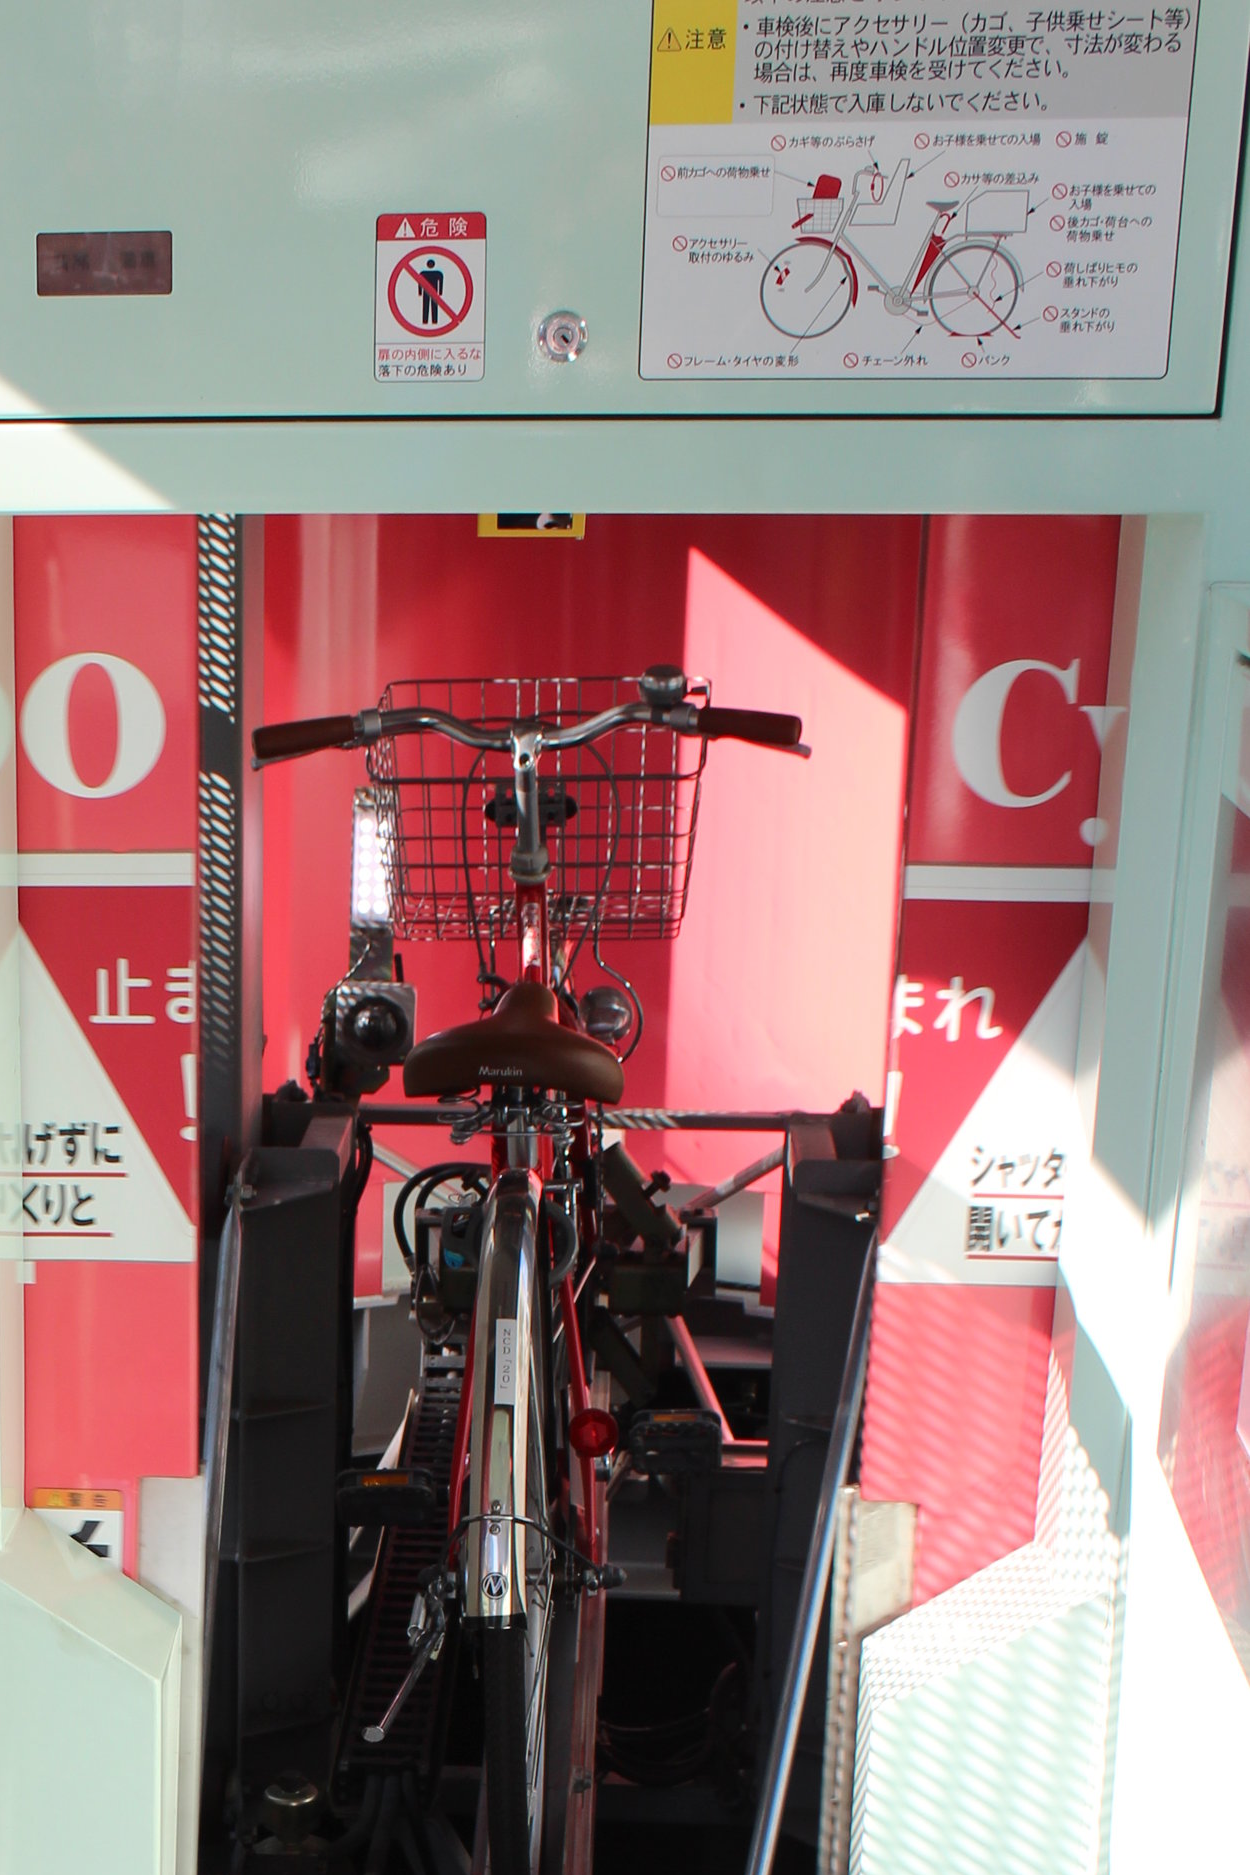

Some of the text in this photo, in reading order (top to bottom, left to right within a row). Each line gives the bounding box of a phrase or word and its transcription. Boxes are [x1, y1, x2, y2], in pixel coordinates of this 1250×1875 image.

[685, 28, 727, 50] 注意
[754, 32, 1182, 60] の付け替えやハンドル位置変更で、寸法が変わる
[754, 59, 1070, 84] 場合は、再度車検を受けてください。
[754, 91, 1049, 115] 下記状態で入庫しないでください。
[789, 135, 875, 148] カギ等のぶらさげ
[933, 132, 1041, 146] お子様を乗せての入場
[677, 165, 771, 179] 前カゴへの荷物乗せ
[961, 172, 1039, 185] カサ等の差込み
[1069, 184, 1156, 198] お子様を乗せての
[1069, 198, 1092, 211] 入場
[420, 217, 468, 237] 危険
[1066, 229, 1115, 243] 荷物乗せ
[689, 238, 748, 250] アクセサリー
[688, 251, 754, 264] 取付のゆるみ
[1063, 275, 1119, 288] 垂れ下がり
[1060, 307, 1110, 319] スタンドの
[1059, 320, 1115, 333] 垂れ下がり
[378, 347, 481, 361] 扉の内側に入るな
[862, 354, 928, 367] チェーン外れ
[378, 364, 468, 377] 落下の危険あり
[20, 652, 166, 799] O
[478, 1066, 523, 1076] Marukin
